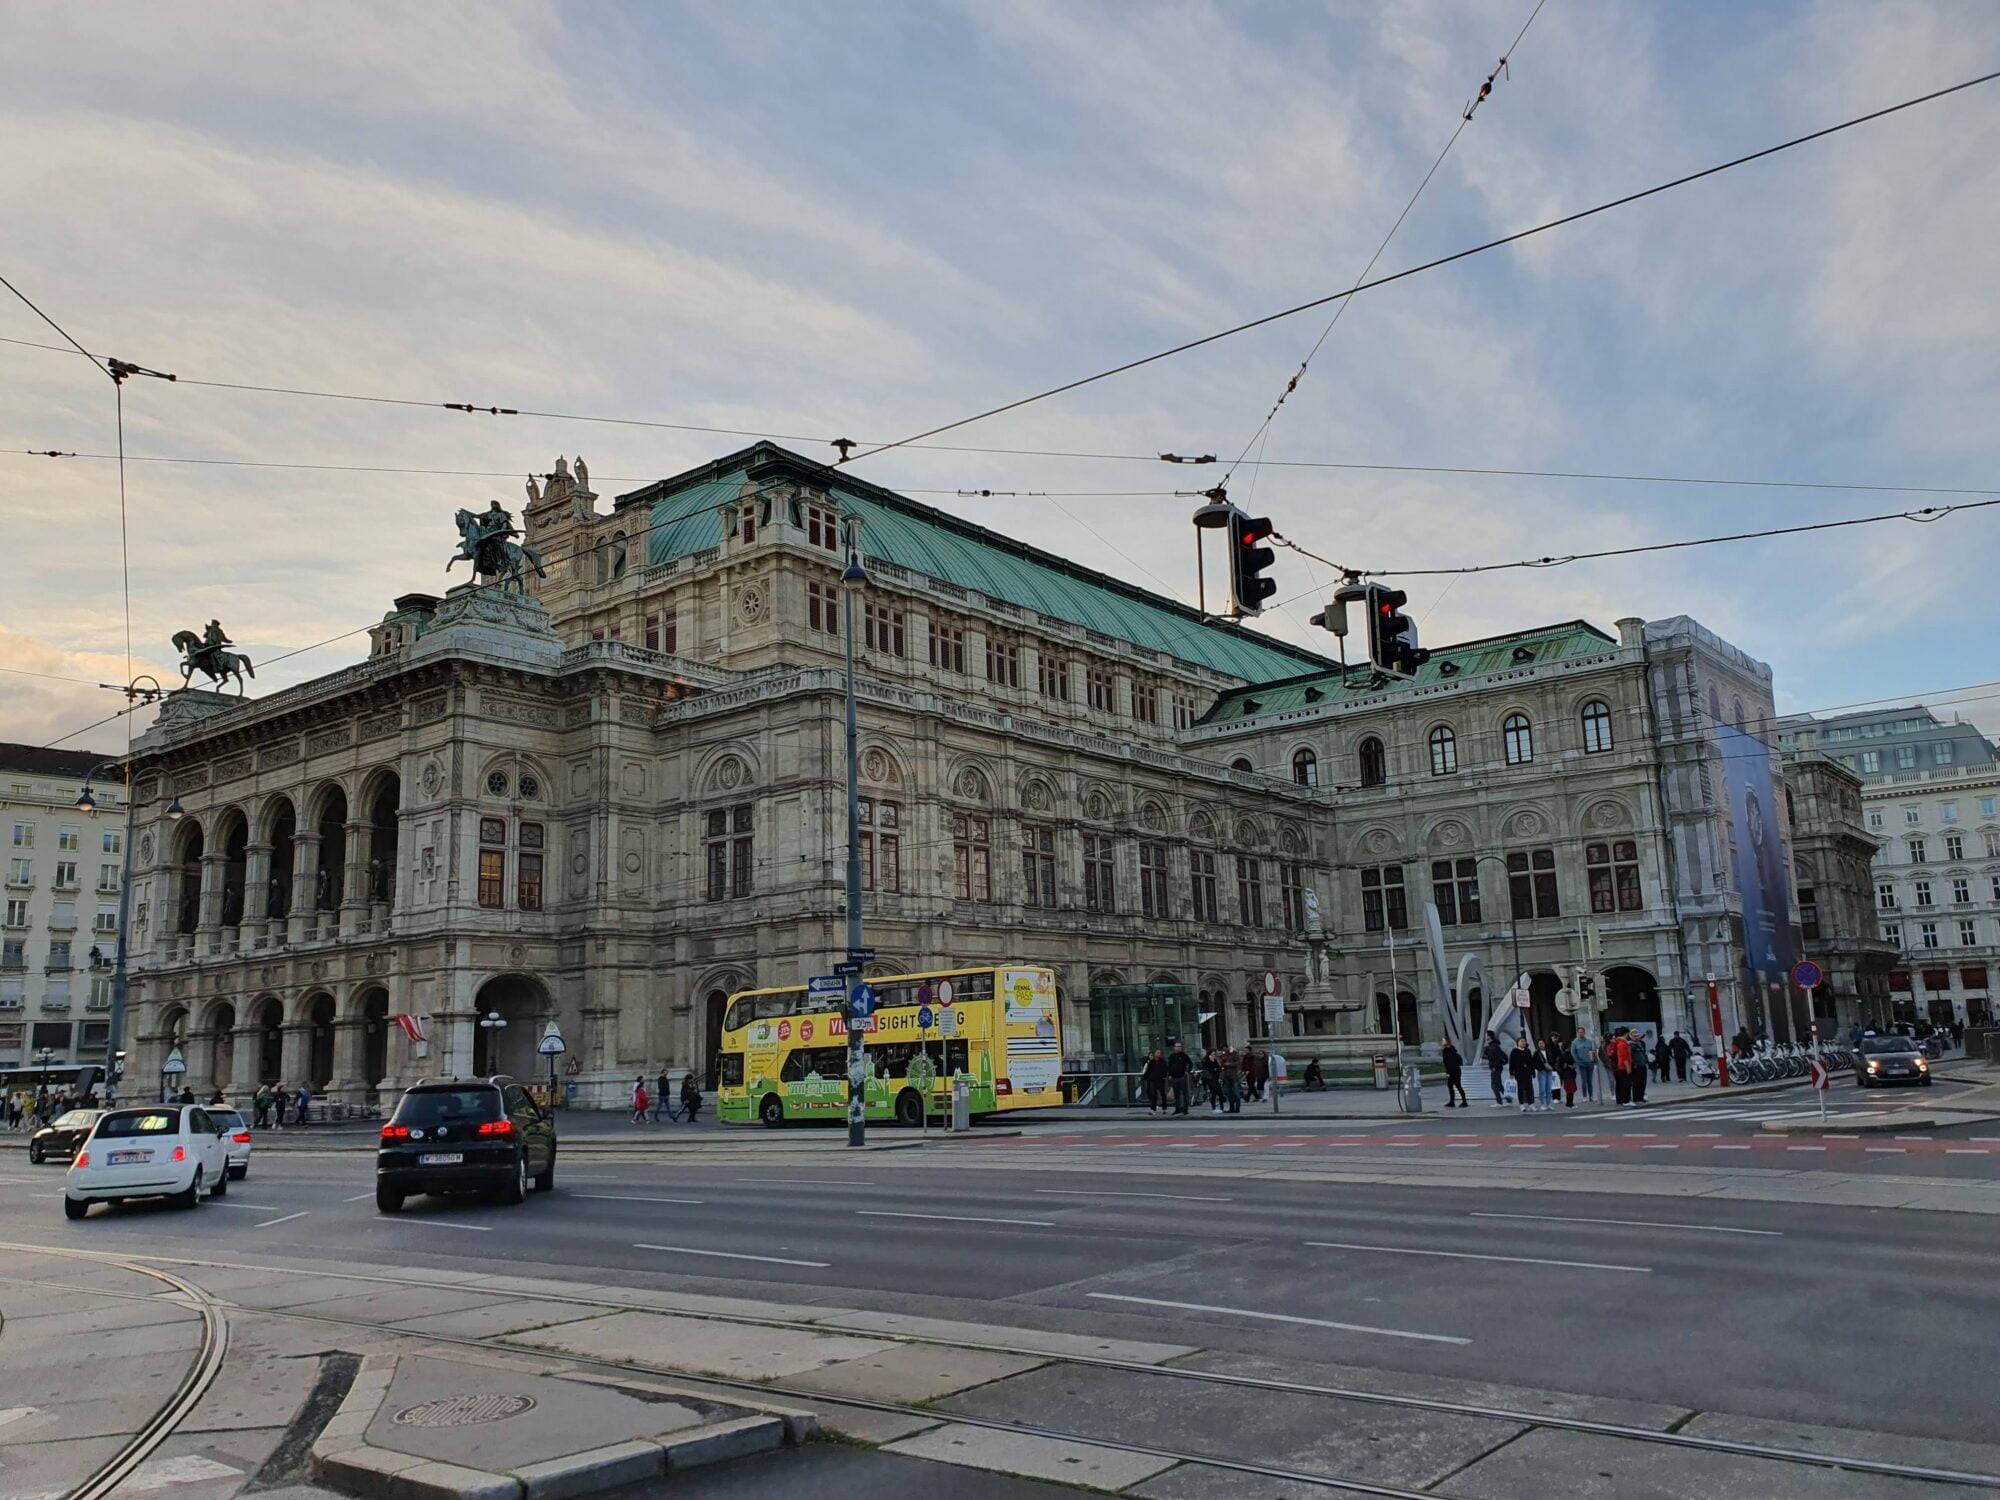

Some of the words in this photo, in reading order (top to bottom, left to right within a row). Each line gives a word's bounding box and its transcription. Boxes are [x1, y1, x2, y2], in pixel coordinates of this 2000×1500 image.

[820, 979, 841, 988] EINBAHN
[1016, 991, 1034, 1001] PASS
[880, 1011, 965, 1031] SIGHTEG
